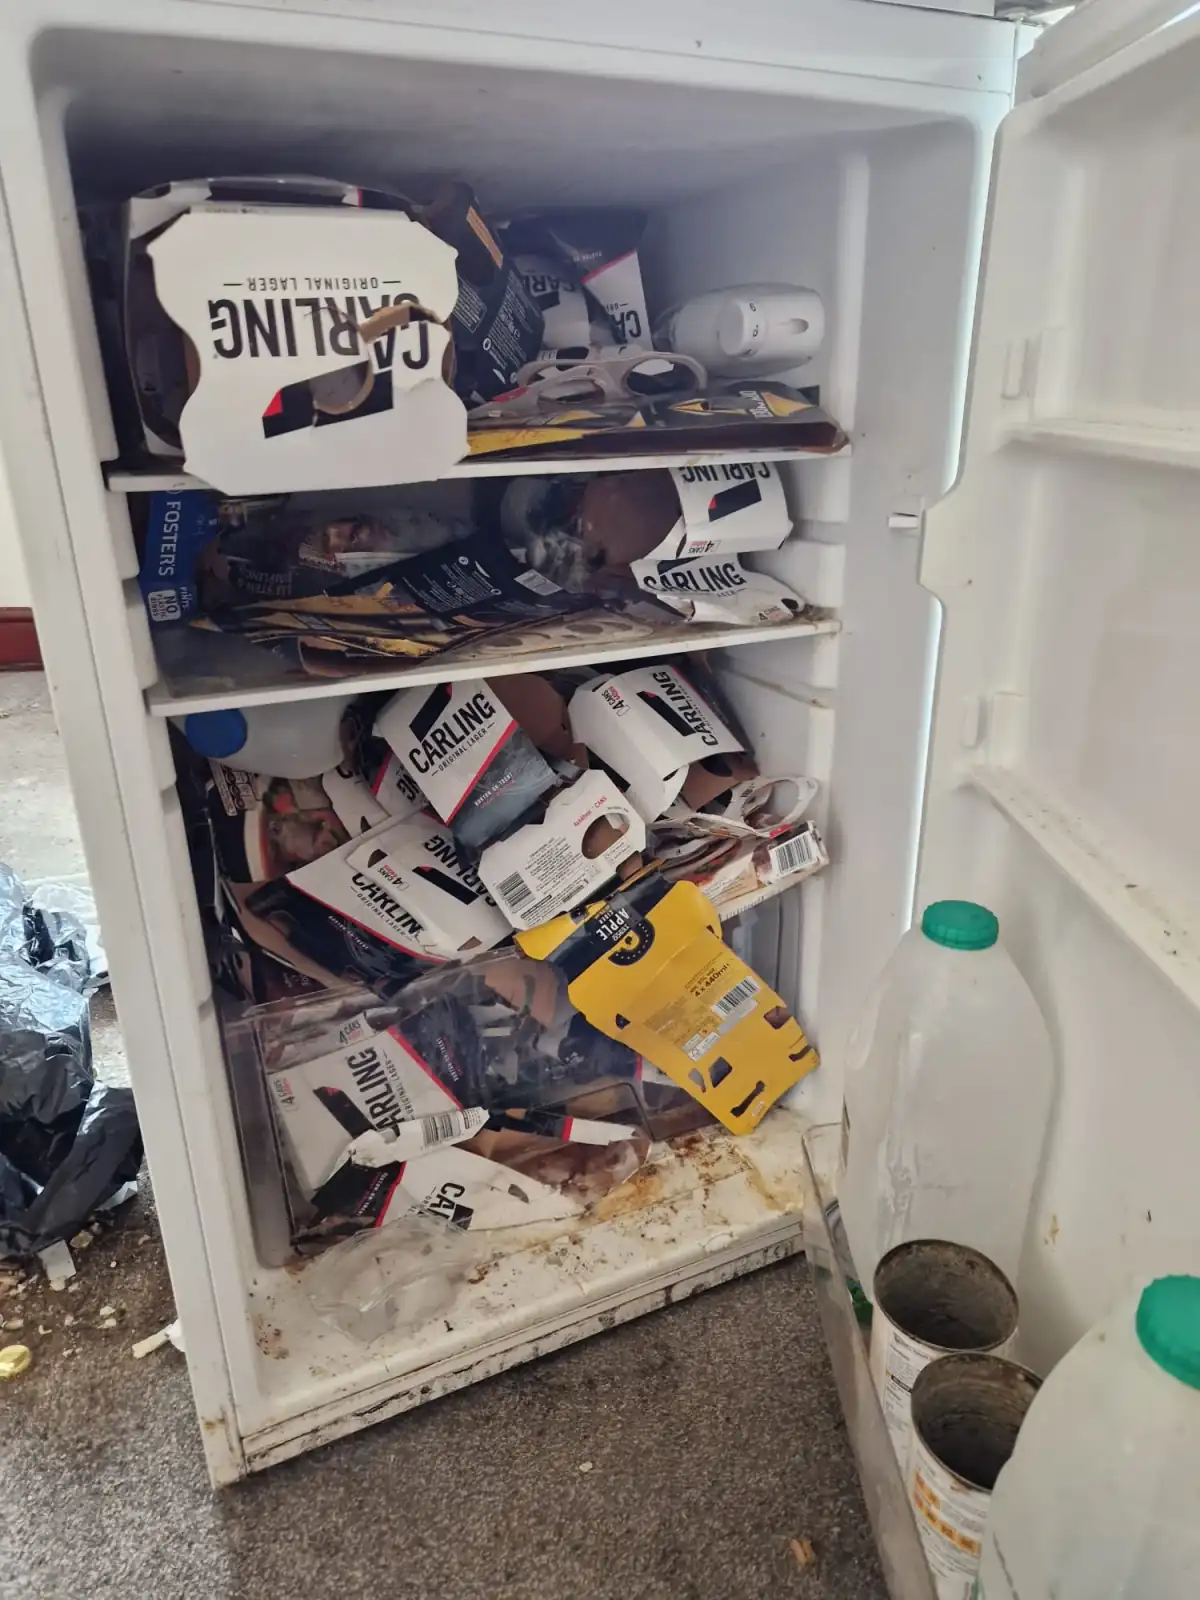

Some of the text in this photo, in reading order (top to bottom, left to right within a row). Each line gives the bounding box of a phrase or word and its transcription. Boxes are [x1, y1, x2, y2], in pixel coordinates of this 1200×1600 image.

[248, 277, 379, 291] ORIGINAL LAGER
[208, 293, 430, 370] CARLING
[158, 501, 181, 576] FOSTER'S
[704, 540, 714, 553] 4
[643, 563, 747, 594] CARLING
[165, 595, 179, 614] NO
[601, 690, 625, 710] 4 CANS
[653, 671, 719, 746] CARLING
[409, 691, 496, 774] CARLING
[439, 728, 487, 772] ORIGINAL LAGER
[594, 796, 608, 809] CANS
[377, 867, 403, 885] 4 CANS
[352, 872, 425, 935] CARLIN
[356, 892, 406, 937] ORIGINAL LAGER
[596, 907, 631, 941] APPLE
[612, 924, 630, 942] TESCO
[694, 990, 701, 998] 4
[339, 1028, 348, 1045] 4
[344, 1020, 362, 1036] CANS
[347, 1046, 405, 1137] ARLING
[385, 1059, 414, 1115] ORIGINAL LAGER
